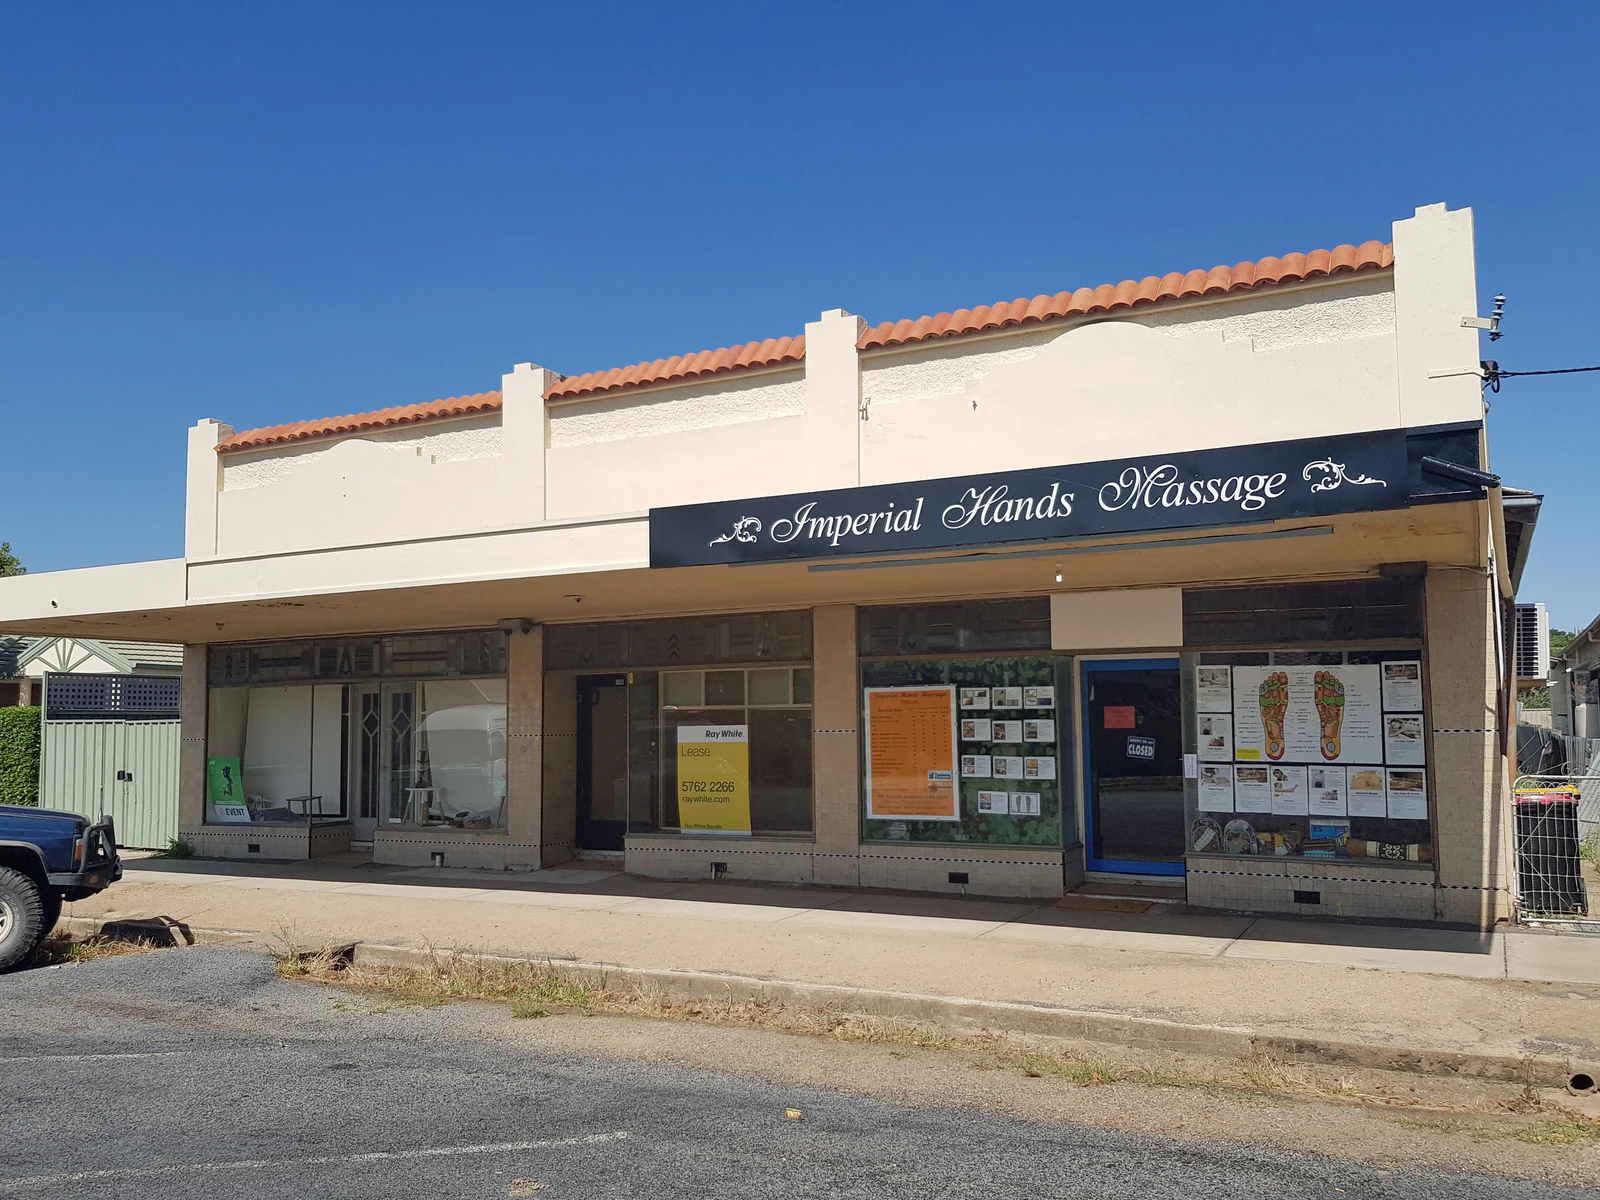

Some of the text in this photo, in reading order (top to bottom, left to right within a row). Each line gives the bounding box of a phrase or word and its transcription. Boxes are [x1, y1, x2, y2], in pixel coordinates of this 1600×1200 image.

[770, 464, 1288, 547] Imperial Hands Massage
[705, 730, 720, 739] Ray
[681, 746, 711, 757] Lease
[1128, 744, 1153, 757] CLOSED
[682, 781, 735, 792] 5762 2266
[682, 795, 730, 804] raywhite.com
[225, 808, 245, 816] EVENT
